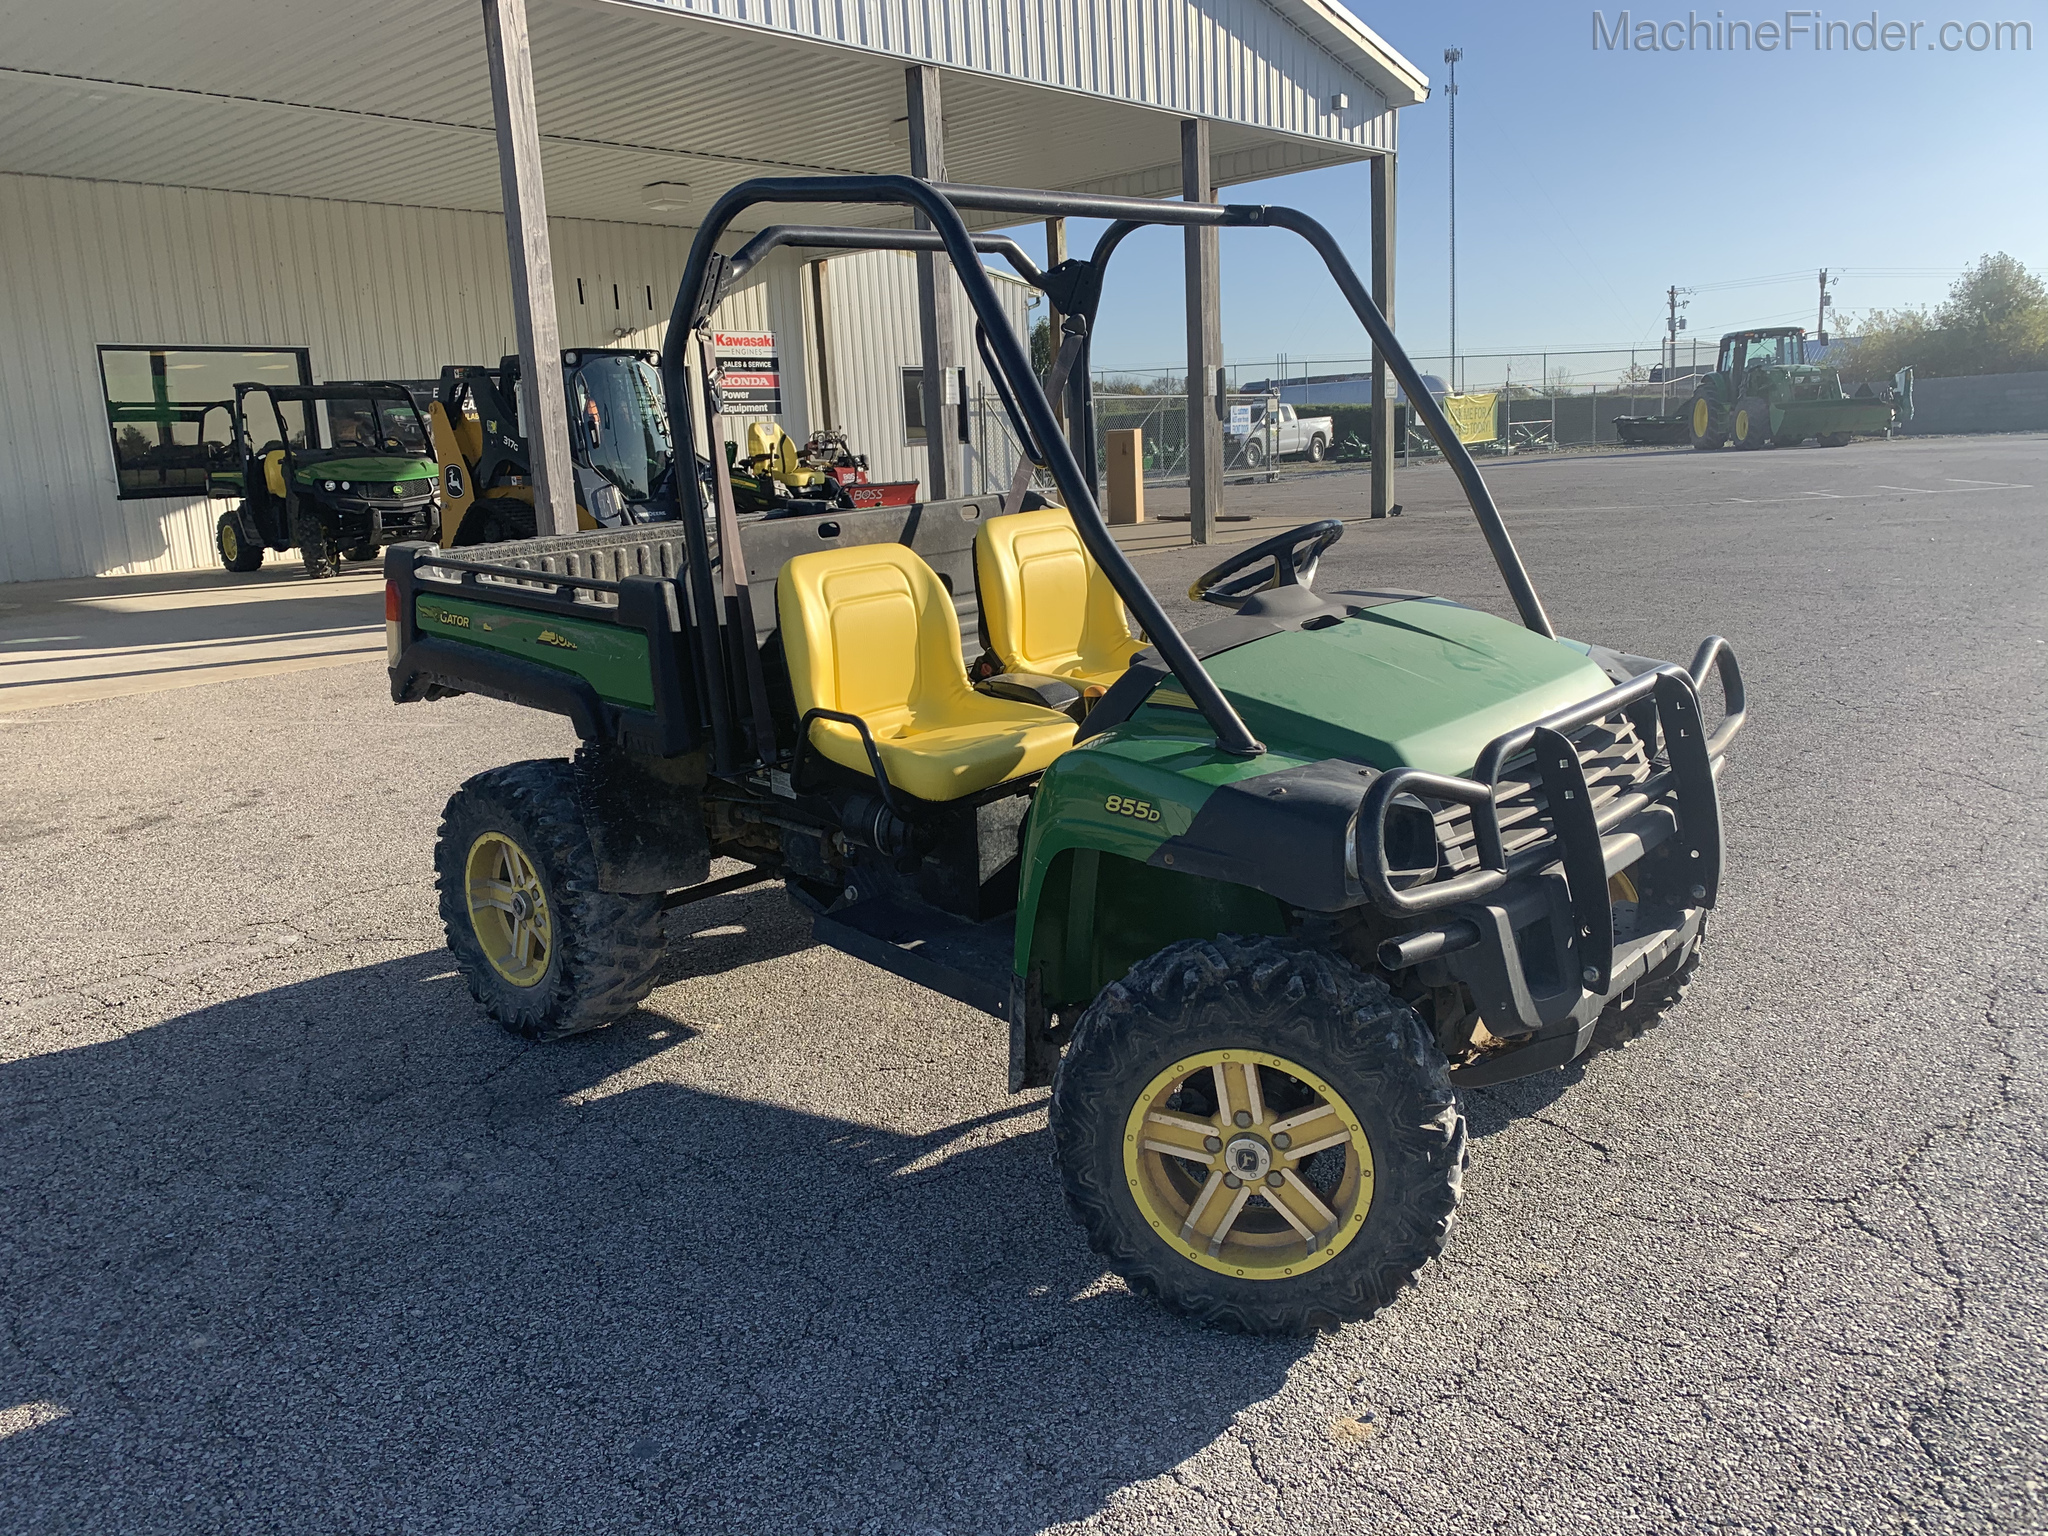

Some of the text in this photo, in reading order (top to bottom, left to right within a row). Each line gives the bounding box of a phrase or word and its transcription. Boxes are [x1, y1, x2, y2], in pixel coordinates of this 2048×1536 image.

[715, 334, 775, 347] Kawasaki
[721, 377, 769, 386] HONDA
[722, 390, 749, 399] Power
[723, 403, 768, 414] Equipment
[503, 435, 519, 452] 317G
[854, 488, 885, 501] BOSS
[440, 611, 470, 629] GATOR
[1105, 795, 1161, 822] 855D
